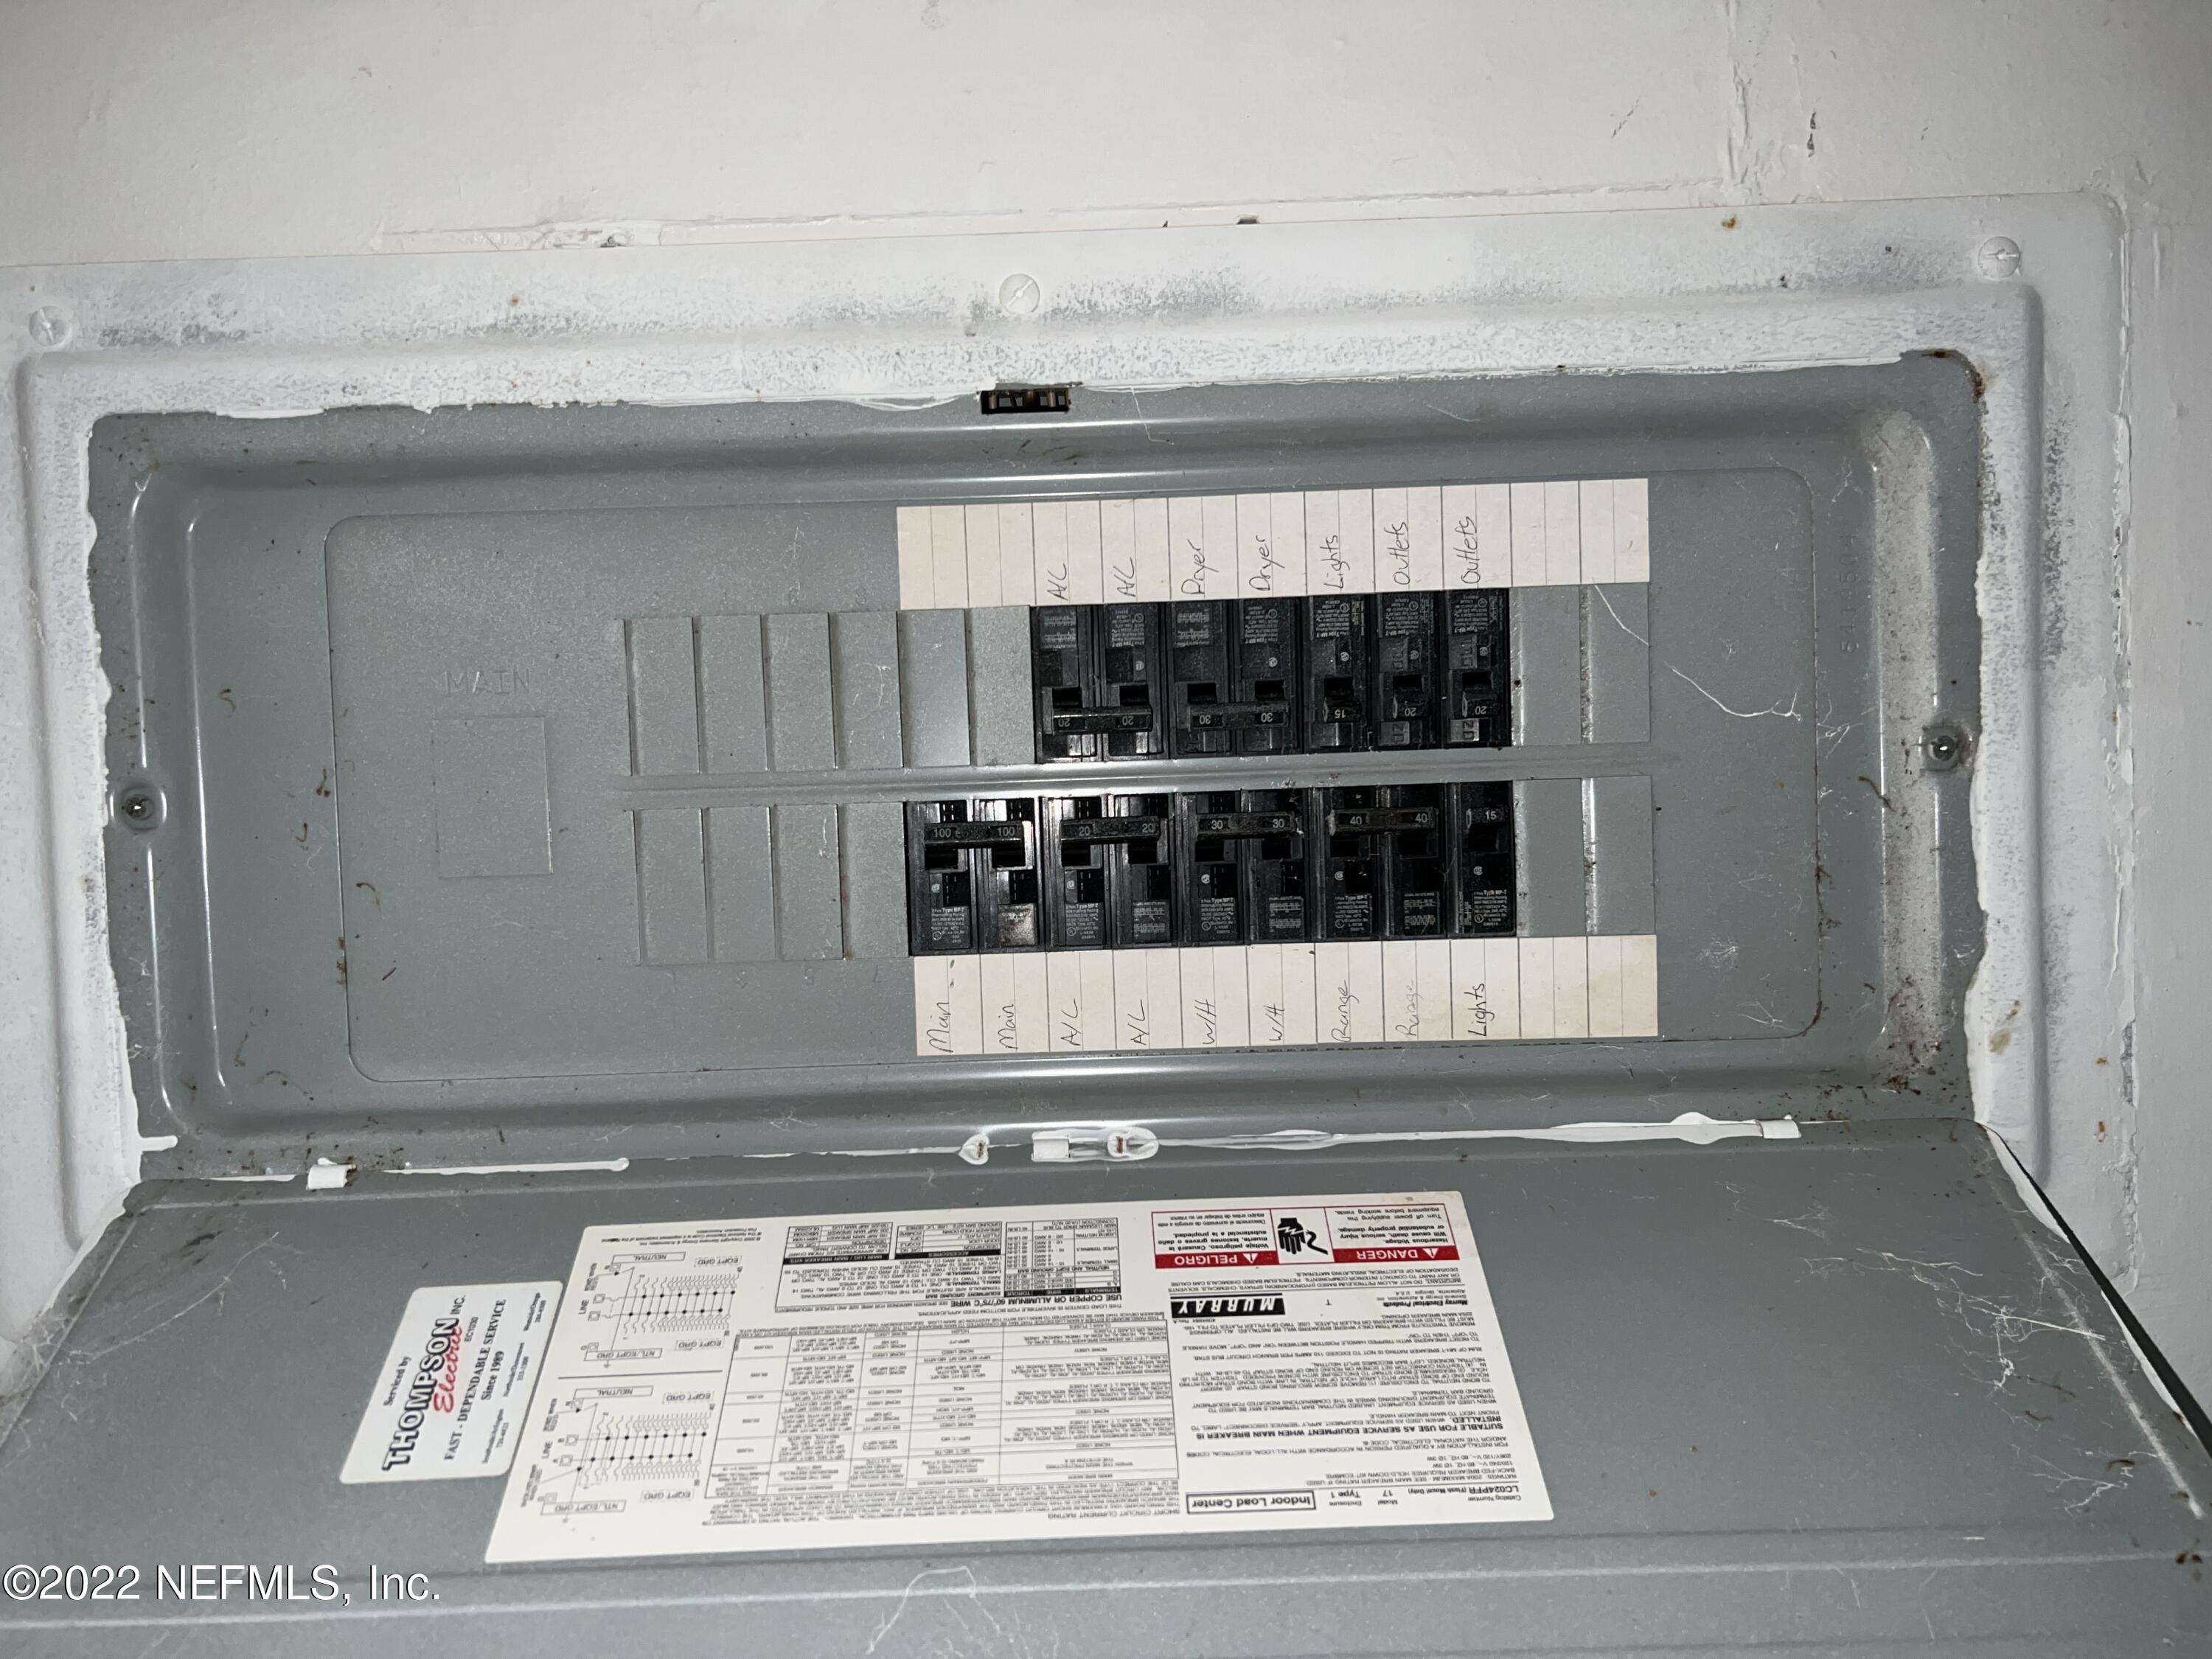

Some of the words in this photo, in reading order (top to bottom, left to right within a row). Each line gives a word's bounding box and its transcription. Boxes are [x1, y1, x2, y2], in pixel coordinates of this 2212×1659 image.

[1384, 521, 1411, 585] Outlets
[1453, 516, 1481, 583] Outlets
[1180, 538, 1219, 595] Dryer
[1249, 535, 1284, 591] Dryer
[1319, 535, 1350, 588] Lights
[444, 668, 530, 695] MAIN
[1335, 710, 1346, 718] 15
[1405, 708, 1416, 716] 20
[1475, 706, 1487, 714] 20
[1058, 718, 1070, 726] 20
[1122, 716, 1134, 726] 20
[1200, 715, 1211, 724] 30
[1261, 713, 1273, 723] 30
[1350, 816, 1362, 825] 40
[1415, 813, 1427, 822] 40
[1486, 811, 1496, 820] 15
[1143, 824, 1154, 832] 20
[1211, 820, 1222, 829] 30
[1273, 819, 1284, 828] 30
[933, 828, 951, 838] 100
[998, 827, 1015, 836] 100
[1079, 826, 1090, 836] 20
[1332, 979, 1360, 1043] Range
[1464, 983, 1495, 1037] Lights
[998, 1004, 1019, 1050] Main
[1357, 1250, 1418, 1259] DANGER
[1175, 1255, 1237, 1265] PELIGRO
[578, 1300, 588, 1315] LINE
[1178, 1298, 1276, 1314] MURRAY
[434, 1327, 462, 1413] Electric
[444, 1431, 462, 1460] FAST
[457, 1346, 490, 1423] DEPENDABLE
[484, 1299, 506, 1345] SERVICE
[481, 1373, 497, 1401] Since
[490, 1351, 504, 1371] 1989
[382, 1317, 459, 1472] THOMPSON
[451, 1295, 466, 1315] INC.
[383, 1370, 404, 1407] Serviced
[398, 1357, 411, 1368] by
[1207, 1430, 1251, 1439] BREAKER
[1307, 1427, 1360, 1436] EQUIPMENT
[542, 1442, 552, 1458] LINE
[1338, 1490, 1360, 1498] Type
[1192, 1498, 1232, 1508] Center
[1237, 1498, 1266, 1507] Load
[1271, 1496, 1310, 1506] Indoor
